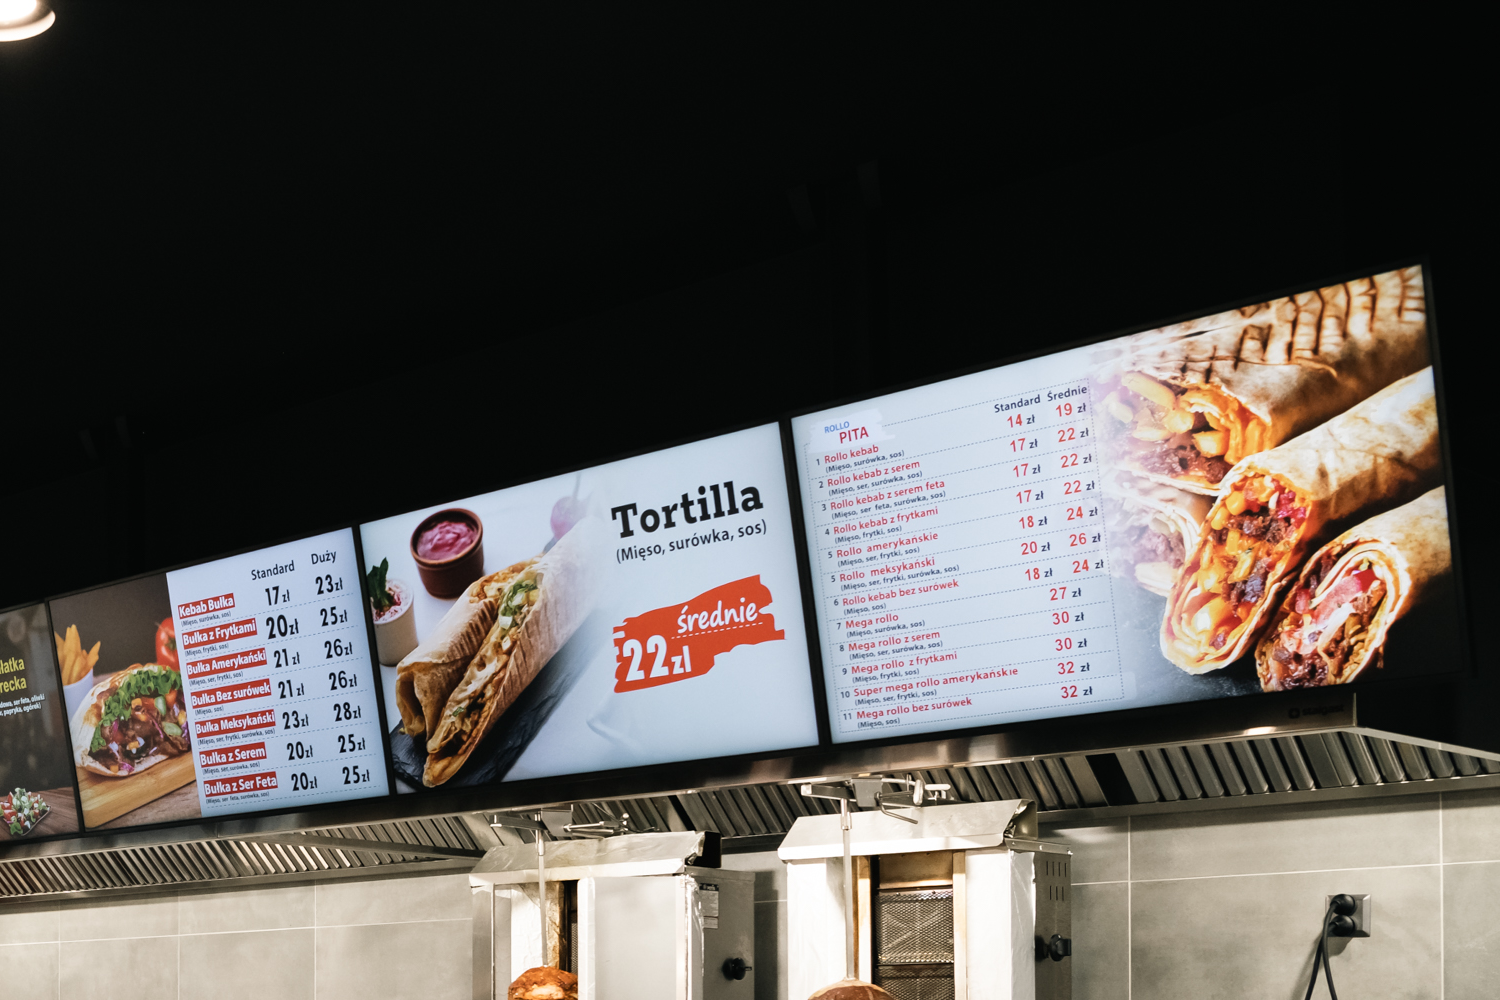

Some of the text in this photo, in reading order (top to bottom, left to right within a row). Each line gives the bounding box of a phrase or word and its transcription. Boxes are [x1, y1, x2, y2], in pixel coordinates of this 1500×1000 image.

[994, 386, 1087, 413] Standard Średnie
[825, 421, 850, 433] ROLLO
[1007, 403, 1086, 428] 14 zł 19 zł
[839, 427, 869, 443] PITA
[825, 453, 847, 463] Rollo
[850, 444, 878, 458] kebab
[828, 476, 850, 487] Rollo
[853, 468, 881, 481] kebab
[891, 461, 920, 473] serem
[831, 499, 853, 510] Rollo
[856, 491, 884, 504] kebab
[894, 485, 923, 496] serem
[926, 480, 945, 490] feta
[611, 480, 763, 538] Tortilla
[834, 524, 857, 534] Rollo
[859, 517, 887, 529] kebab
[897, 506, 938, 523] frytkami
[616, 519, 767, 564] (Mięso, surówka, sos)
[837, 547, 862, 558] Rollo
[867, 532, 938, 552] amerykańskie
[251, 550, 336, 580] Standard Duży
[840, 571, 865, 582] Rollo
[871, 557, 935, 577] meksykański
[843, 595, 866, 606] Rollo
[868, 589, 896, 602] kebab
[899, 587, 916, 597] bez
[918, 579, 959, 593] surówek
[1049, 587, 1081, 601] 27 zł
[179, 596, 234, 617] Kebab Bułka
[677, 597, 758, 634] średnie
[182, 620, 255, 645] Bułka z Frytkami
[846, 619, 873, 629] Mega
[876, 614, 898, 624] rollo
[849, 641, 875, 651] Mega
[878, 637, 901, 647] rollo
[912, 631, 940, 642] serem
[187, 650, 266, 675] Bułka Amerykański
[852, 664, 878, 674] Mega
[882, 660, 904, 670] rollo
[916, 651, 957, 666] frytkami
[192, 682, 271, 706] Bułka Bez surówek
[841, 691, 850, 699] 10
[854, 686, 882, 698] Super
[886, 682, 913, 693] mega
[916, 678, 939, 688] rollo
[857, 709, 884, 719] Mega
[887, 705, 909, 715] rollo
[912, 702, 929, 712] bez
[932, 697, 972, 710] surówek
[196, 711, 275, 734] Bułka Meksykański
[200, 747, 265, 765] Bułka z Serem
[204, 775, 277, 794] Bułka z Ser Feta
